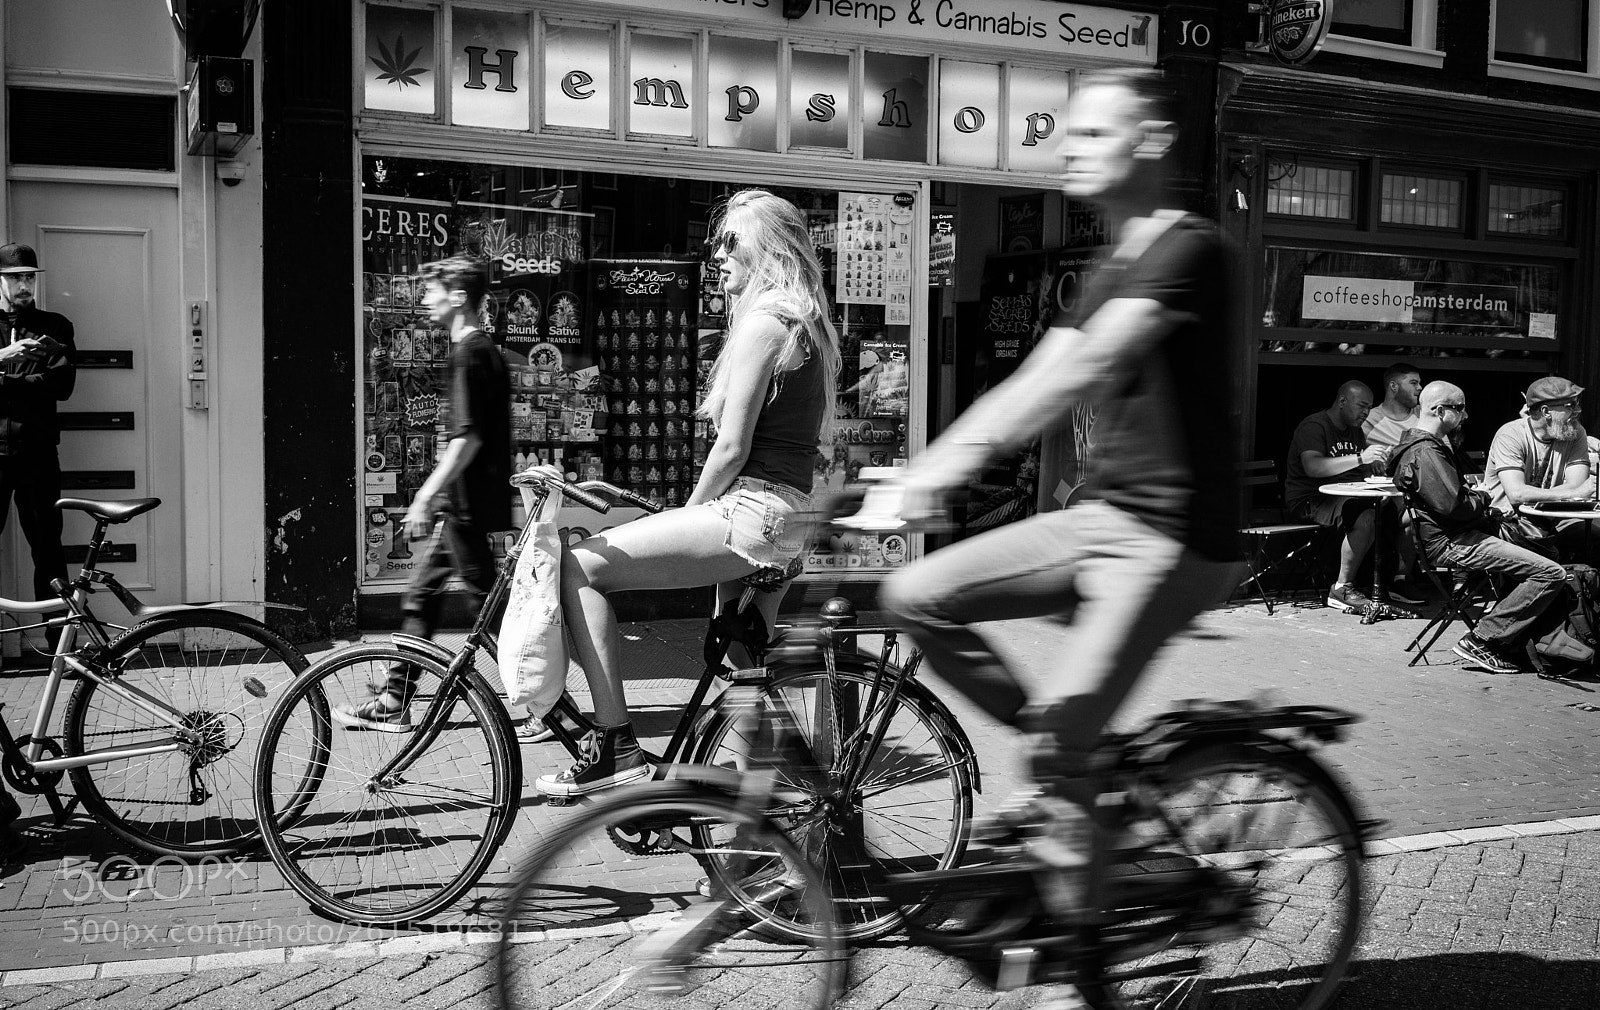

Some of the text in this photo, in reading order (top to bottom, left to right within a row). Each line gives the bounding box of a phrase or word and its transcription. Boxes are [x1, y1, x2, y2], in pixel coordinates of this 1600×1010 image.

[907, 0, 926, 25] &
[935, 0, 1048, 39] Cannabis
[1274, 7, 1316, 26] ineken
[362, 206, 448, 247] CERES
[376, 234, 431, 246] SEEDS
[367, 246, 450, 258] MSTERDAM
[502, 252, 562, 275] Seeds
[1313, 284, 1509, 312] coffeeshop amsterdam
[507, 324, 541, 336] Skunk
[549, 326, 581, 337] Sativa
[505, 335, 542, 344] AMSTERDAM
[547, 337, 566, 345] TRANS
[412, 400, 434, 410] AUTO
